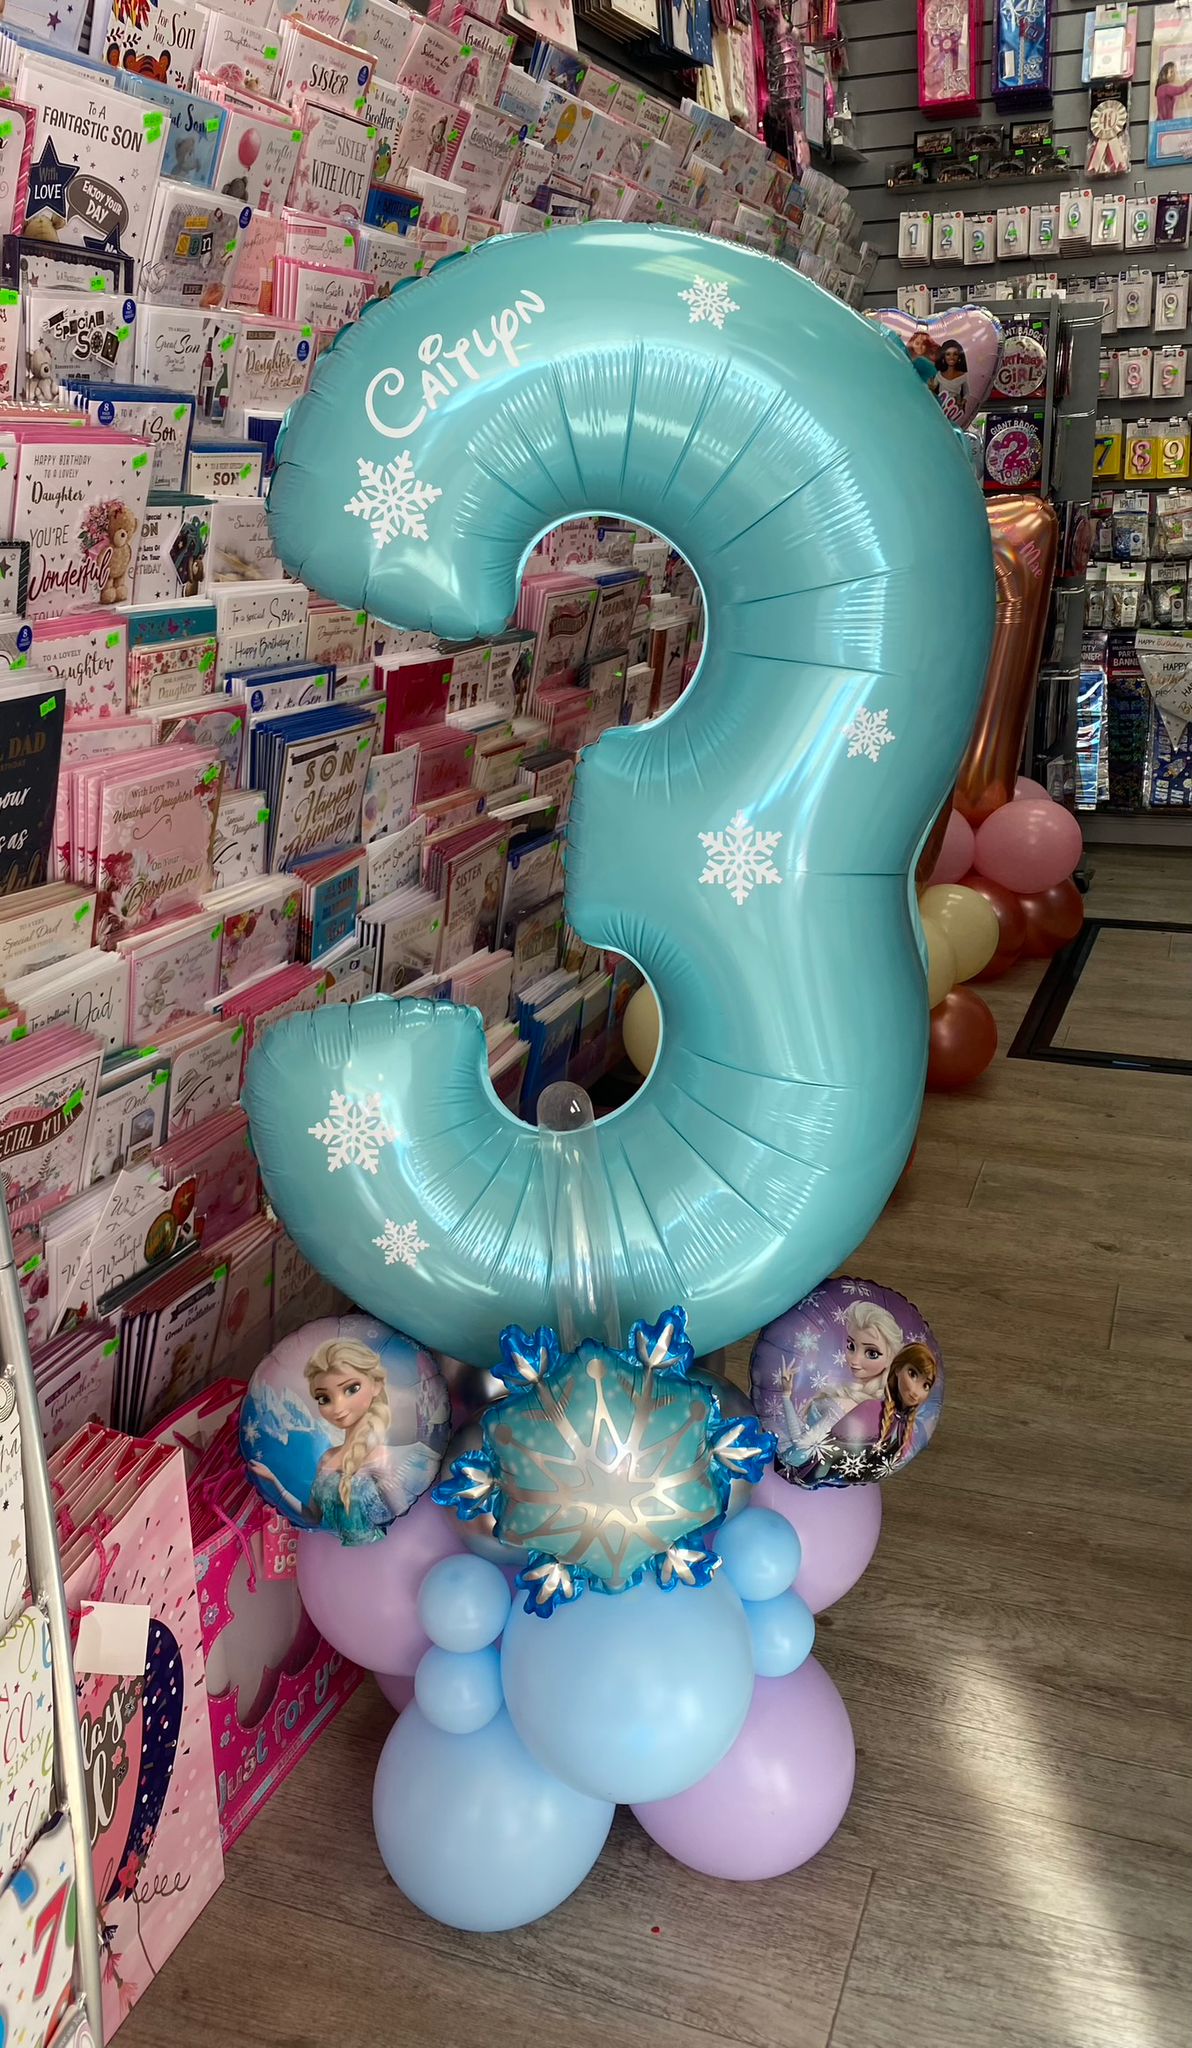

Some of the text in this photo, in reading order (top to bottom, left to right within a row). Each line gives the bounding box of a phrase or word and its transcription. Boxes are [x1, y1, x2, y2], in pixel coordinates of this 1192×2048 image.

[158, 9, 170, 27] For
[167, 13, 196, 50] Son
[309, 63, 349, 96] SISTER
[88, 101, 107, 120] To A
[364, 104, 396, 131] Brother
[42, 106, 144, 152] FANTASTIC SON
[336, 136, 367, 163] SISTER
[39, 167, 58, 182] With
[34, 183, 62, 200] LOVE
[82, 180, 123, 217] ENJOY YOUR
[85, 200, 109, 225] DAY
[1068, 203, 1081, 225] 6
[1102, 210, 1117, 231] 7
[1134, 210, 1149, 233] 8
[1165, 209, 1179, 232] 9
[908, 224, 920, 247] 1
[941, 225, 955, 247] 2
[973, 230, 986, 252] 3
[1005, 221, 1018, 243] 4
[1039, 221, 1053, 242] 5
[1126, 291, 1140, 315] 8
[155, 334, 200, 355] Great Son
[1018, 325, 1043, 342] BADGE
[1127, 363, 1141, 386] 8
[150, 416, 177, 443] Son
[990, 419, 1039, 436] GIANT BADGE
[34, 455, 92, 466] HAPPY BIRTHDAY
[1000, 430, 1031, 471] 2
[1132, 441, 1151, 470] 8
[1164, 440, 1185, 466] 9
[44, 469, 51, 479] TO
[58, 469, 79, 479] LOVELY
[213, 472, 240, 486] SON
[31, 480, 86, 508] Daughter
[145, 513, 161, 521] pecial
[29, 525, 70, 549] YOU'RE
[141, 522, 158, 538] ON
[29, 547, 113, 601] Wonderful
[268, 597, 297, 629] Son
[43, 652, 51, 662] TO
[58, 649, 82, 660] LOVELY
[234, 637, 292, 661] Happy Birthday
[1118, 650, 1137, 658] PART
[47, 650, 114, 686] Daughter
[1113, 657, 1140, 668] BANNE
[1162, 662, 1188, 671] HAPPY
[9, 731, 47, 759] DAD
[304, 748, 357, 789] SON
[131, 786, 149, 799] With
[149, 782, 165, 794] Love
[112, 790, 193, 825] Wonderful Daughter
[455, 862, 483, 892] SISTER
[2, 917, 64, 953] Special Dad
[73, 985, 114, 1031] Dad
[122, 1090, 151, 1116] Dad
[277, 1532, 298, 1552] fo
[272, 1552, 298, 1575] yo
[315, 1651, 343, 1705] yo
[272, 1682, 312, 1745] for
[7, 1726, 45, 1785] sixty
[218, 1726, 269, 1812] Just
